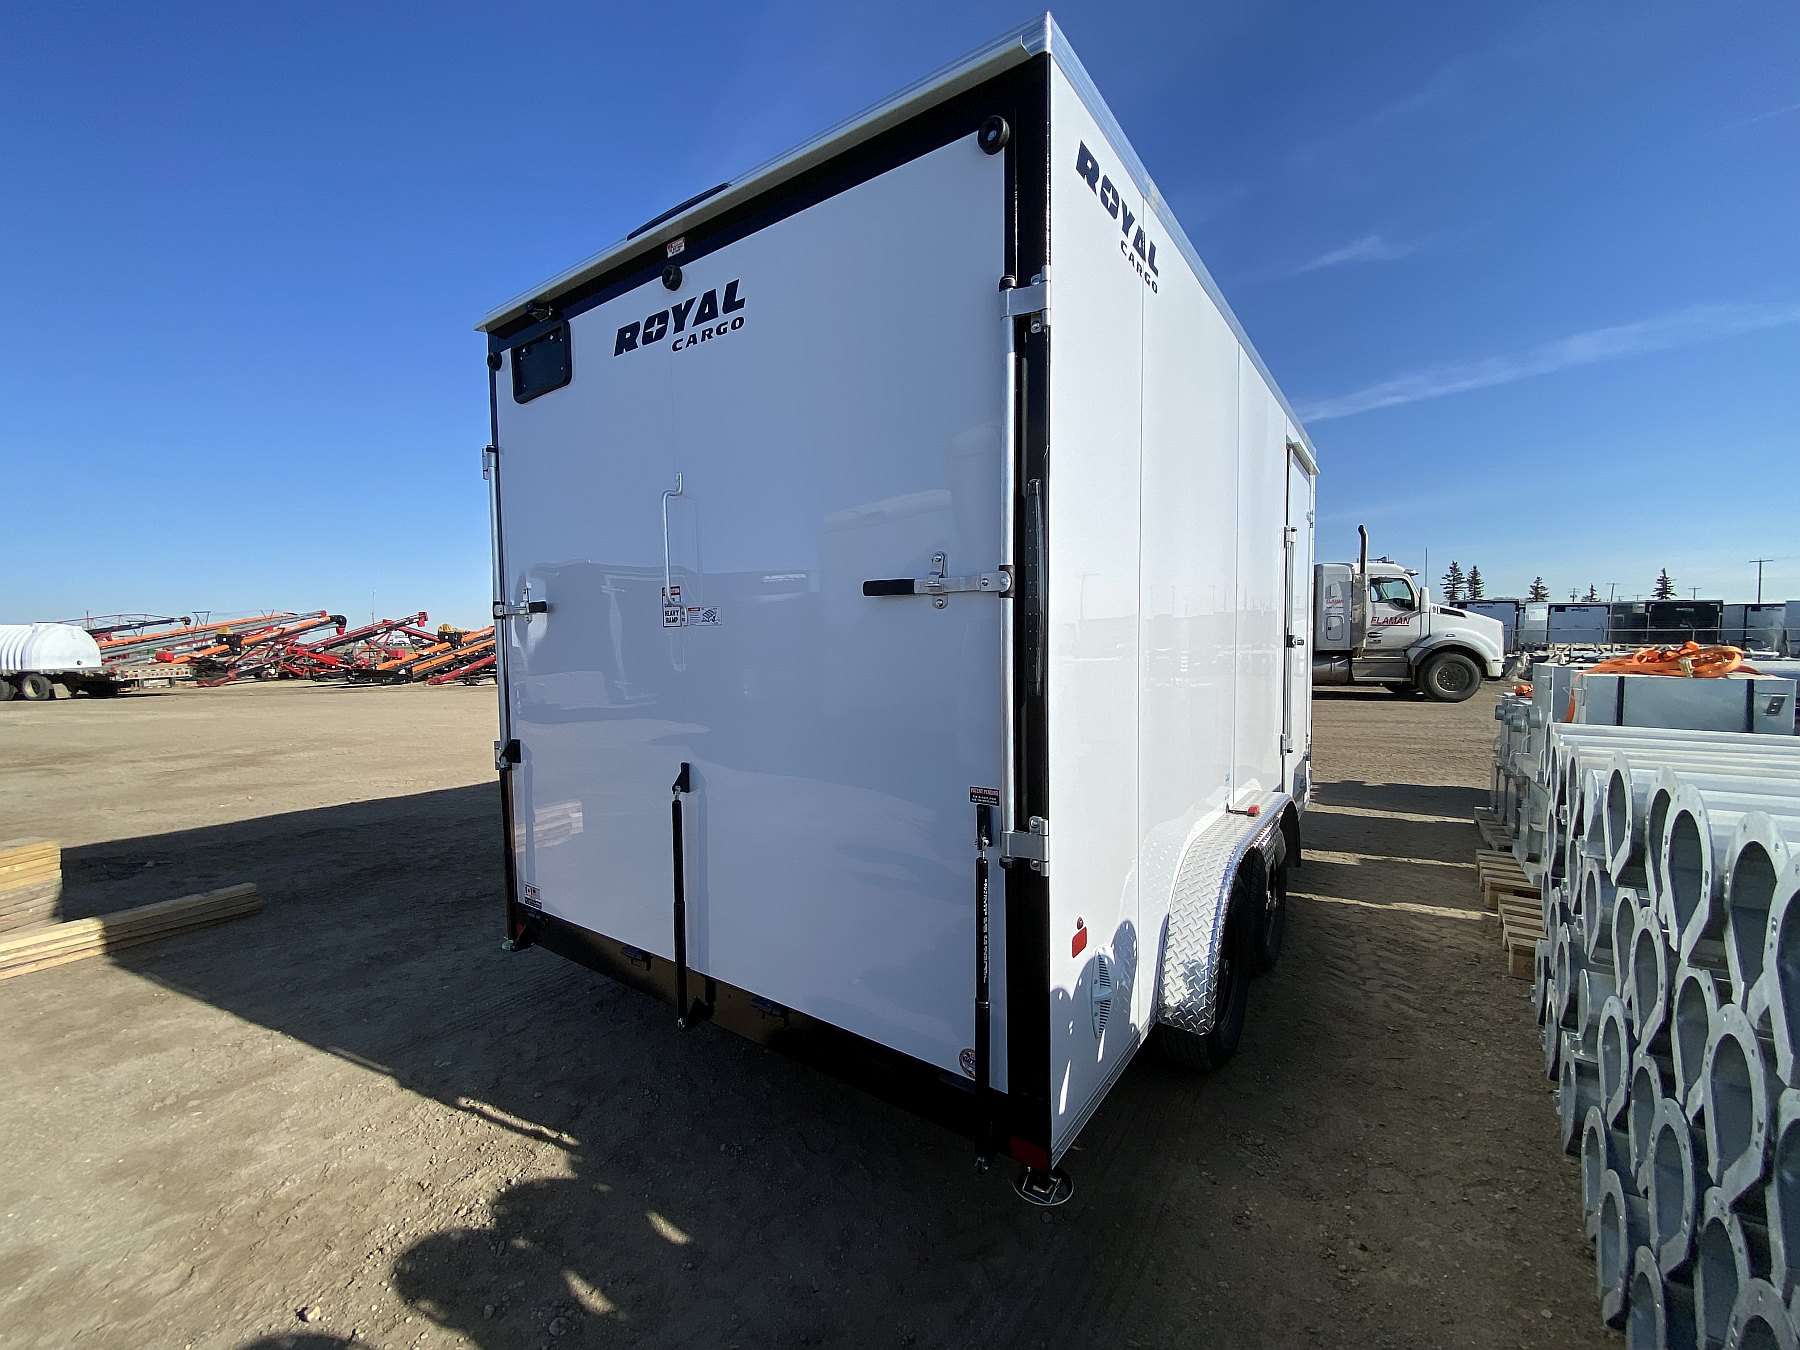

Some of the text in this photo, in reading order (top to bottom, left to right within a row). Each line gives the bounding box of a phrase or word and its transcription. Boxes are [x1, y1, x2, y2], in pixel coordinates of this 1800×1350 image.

[1076, 139, 1159, 278] ROYAL
[1120, 240, 1158, 294] CARGO
[613, 278, 746, 357] ROYAL
[671, 316, 745, 352] CARGO
[1371, 616, 1411, 625] FLAMAN
